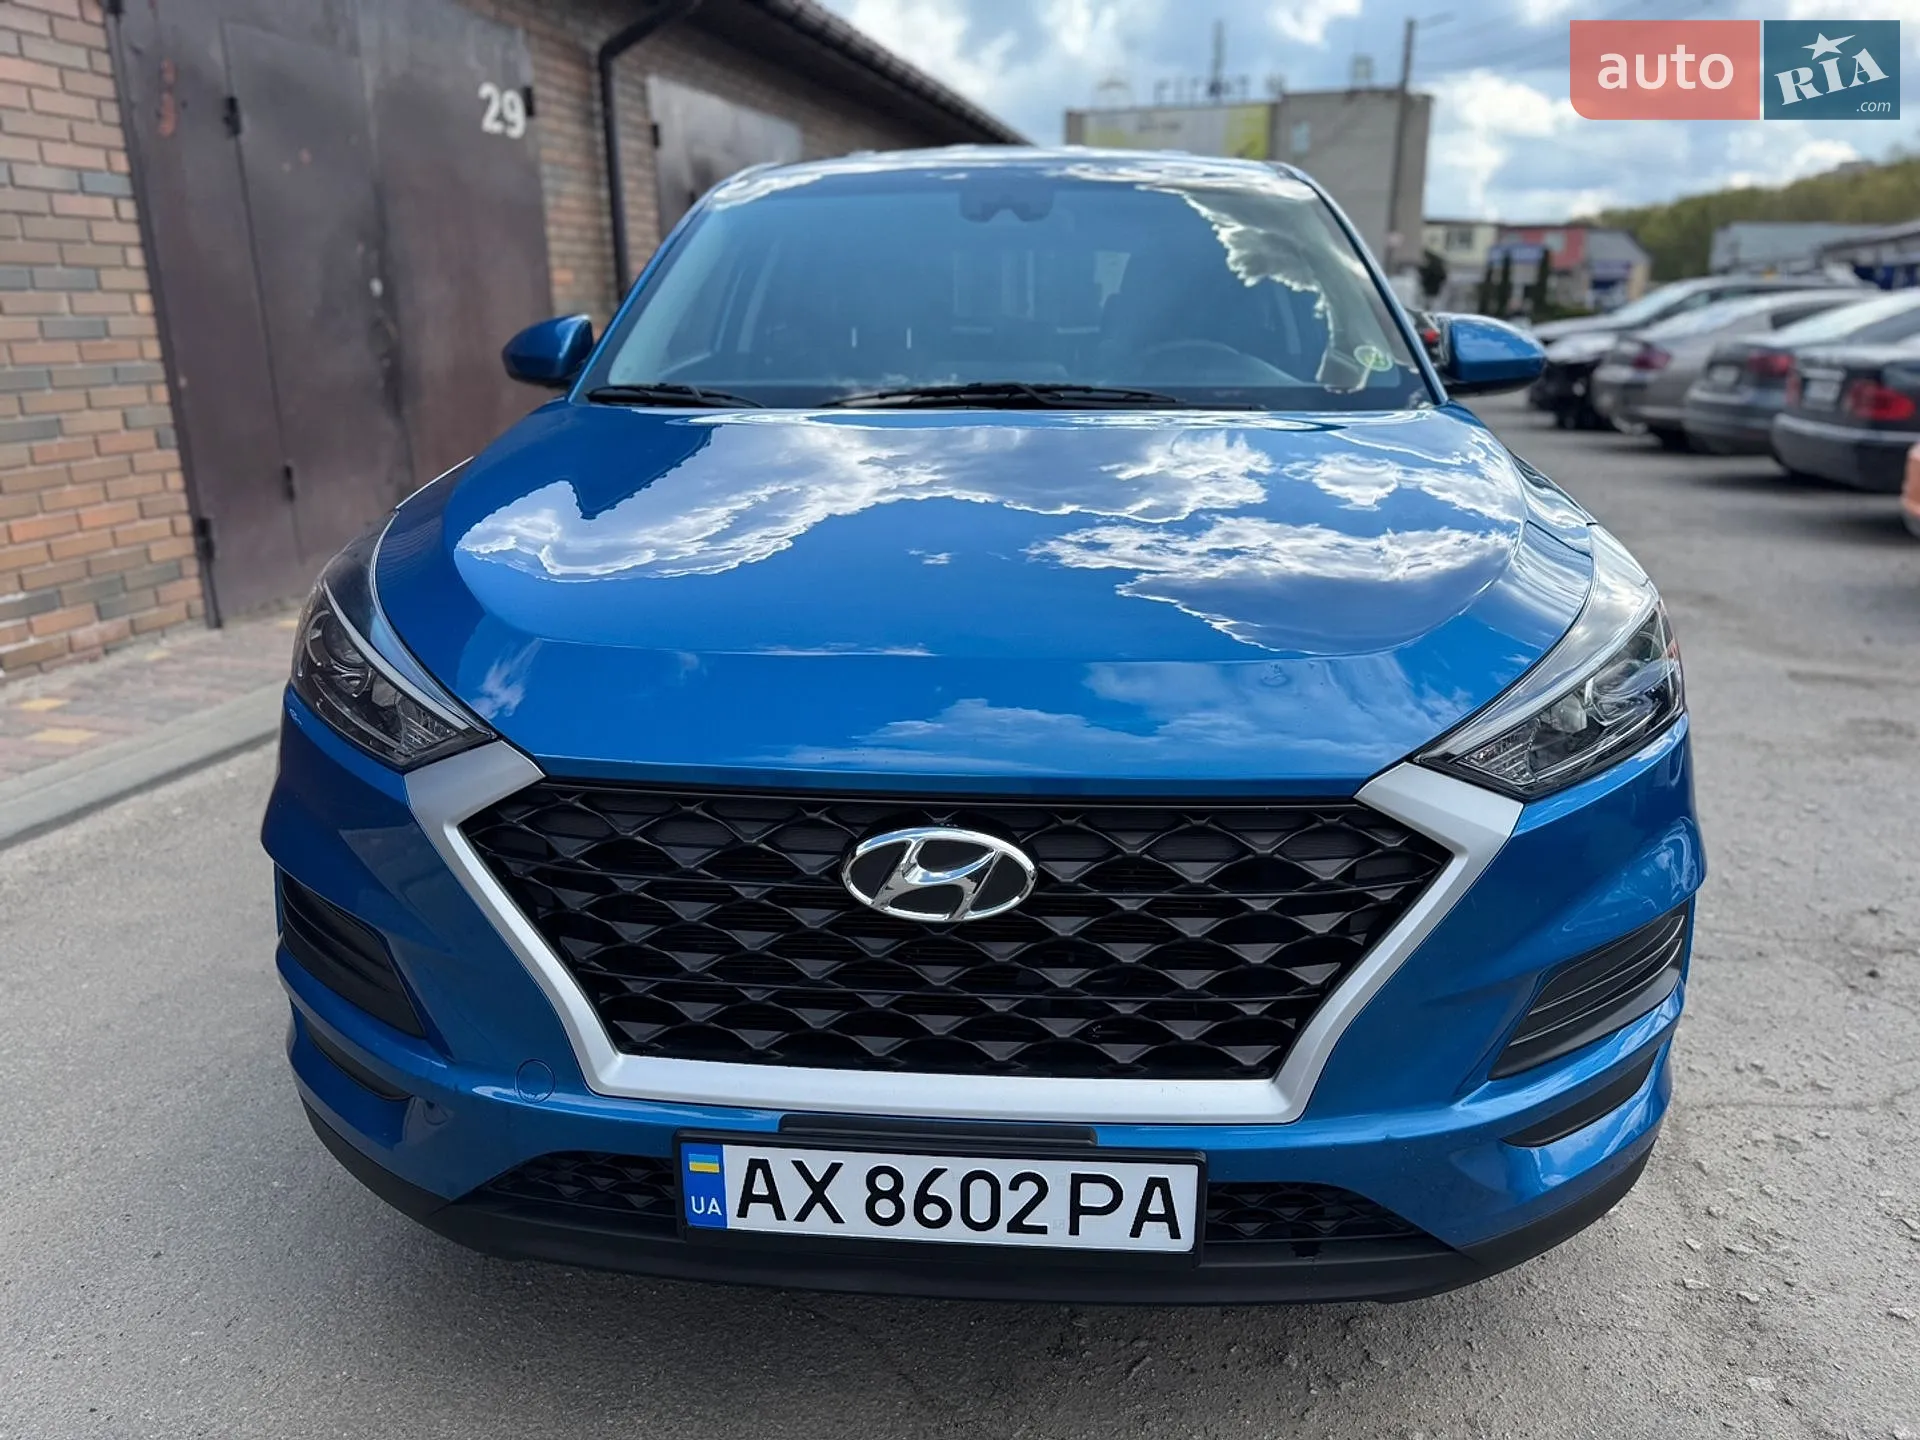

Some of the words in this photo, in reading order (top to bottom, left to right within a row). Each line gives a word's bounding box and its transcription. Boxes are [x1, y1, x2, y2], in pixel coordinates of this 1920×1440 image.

[478, 82, 526, 139] 29
[690, 1194, 723, 1217] UA
[736, 1157, 846, 1225] AX
[864, 1163, 1050, 1236] 8602
[1068, 1172, 1182, 1241] PA
